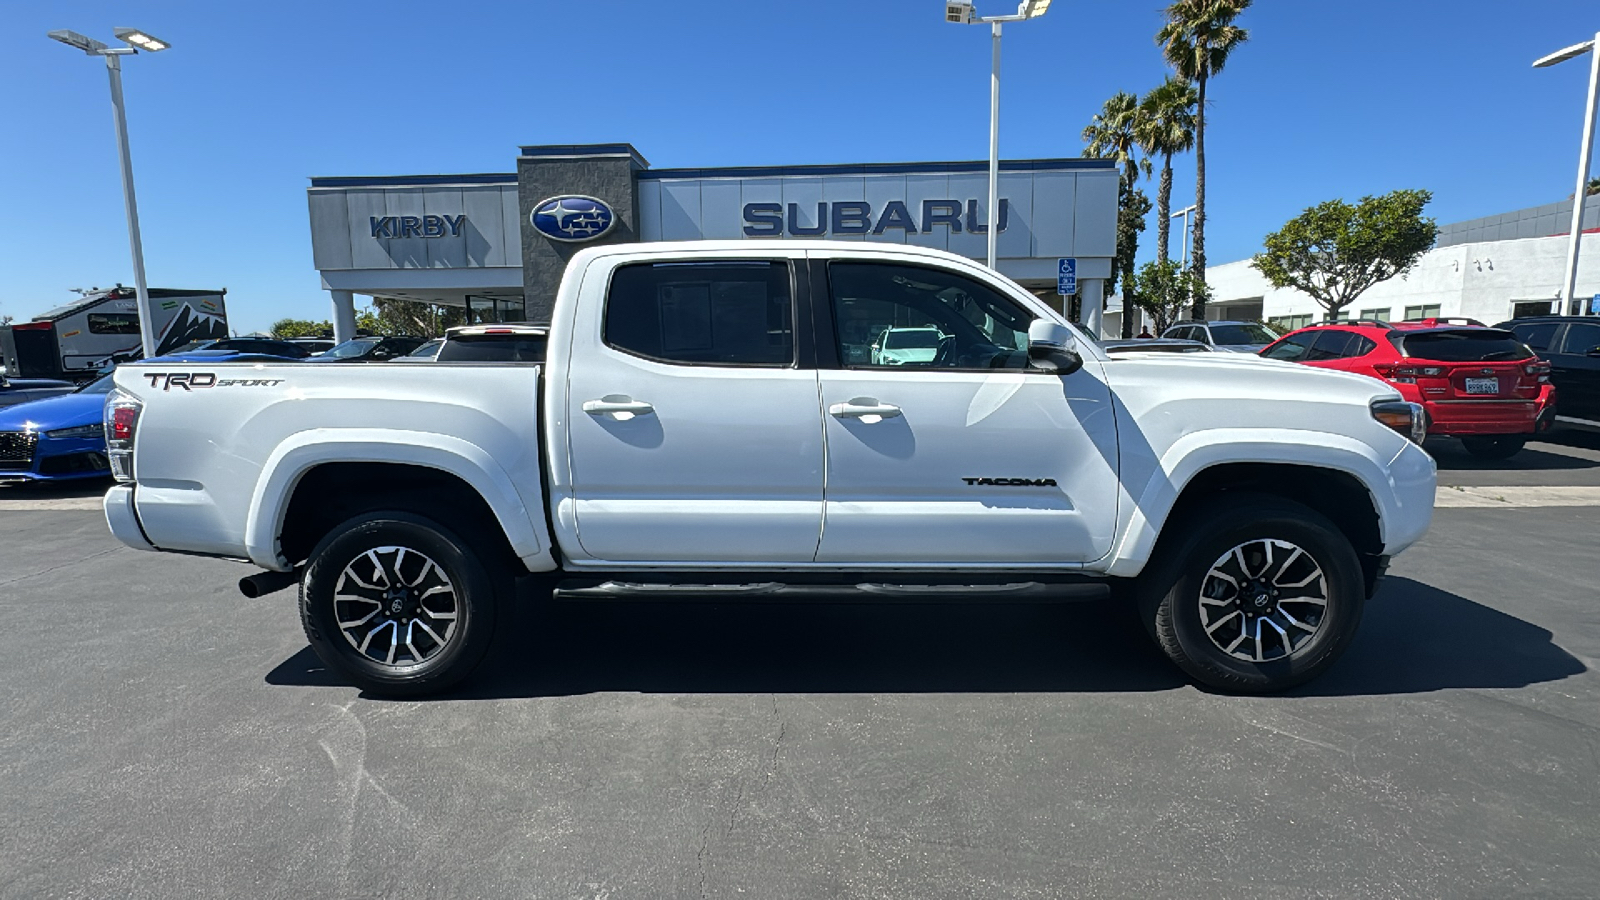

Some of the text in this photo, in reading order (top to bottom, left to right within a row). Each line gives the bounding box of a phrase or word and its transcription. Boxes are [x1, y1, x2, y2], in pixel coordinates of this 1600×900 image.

[370, 214, 466, 238] KIRBY
[743, 198, 1009, 236] SUBARU
[144, 373, 285, 392] TRD SPORT
[962, 477, 1057, 487] TACOMA
